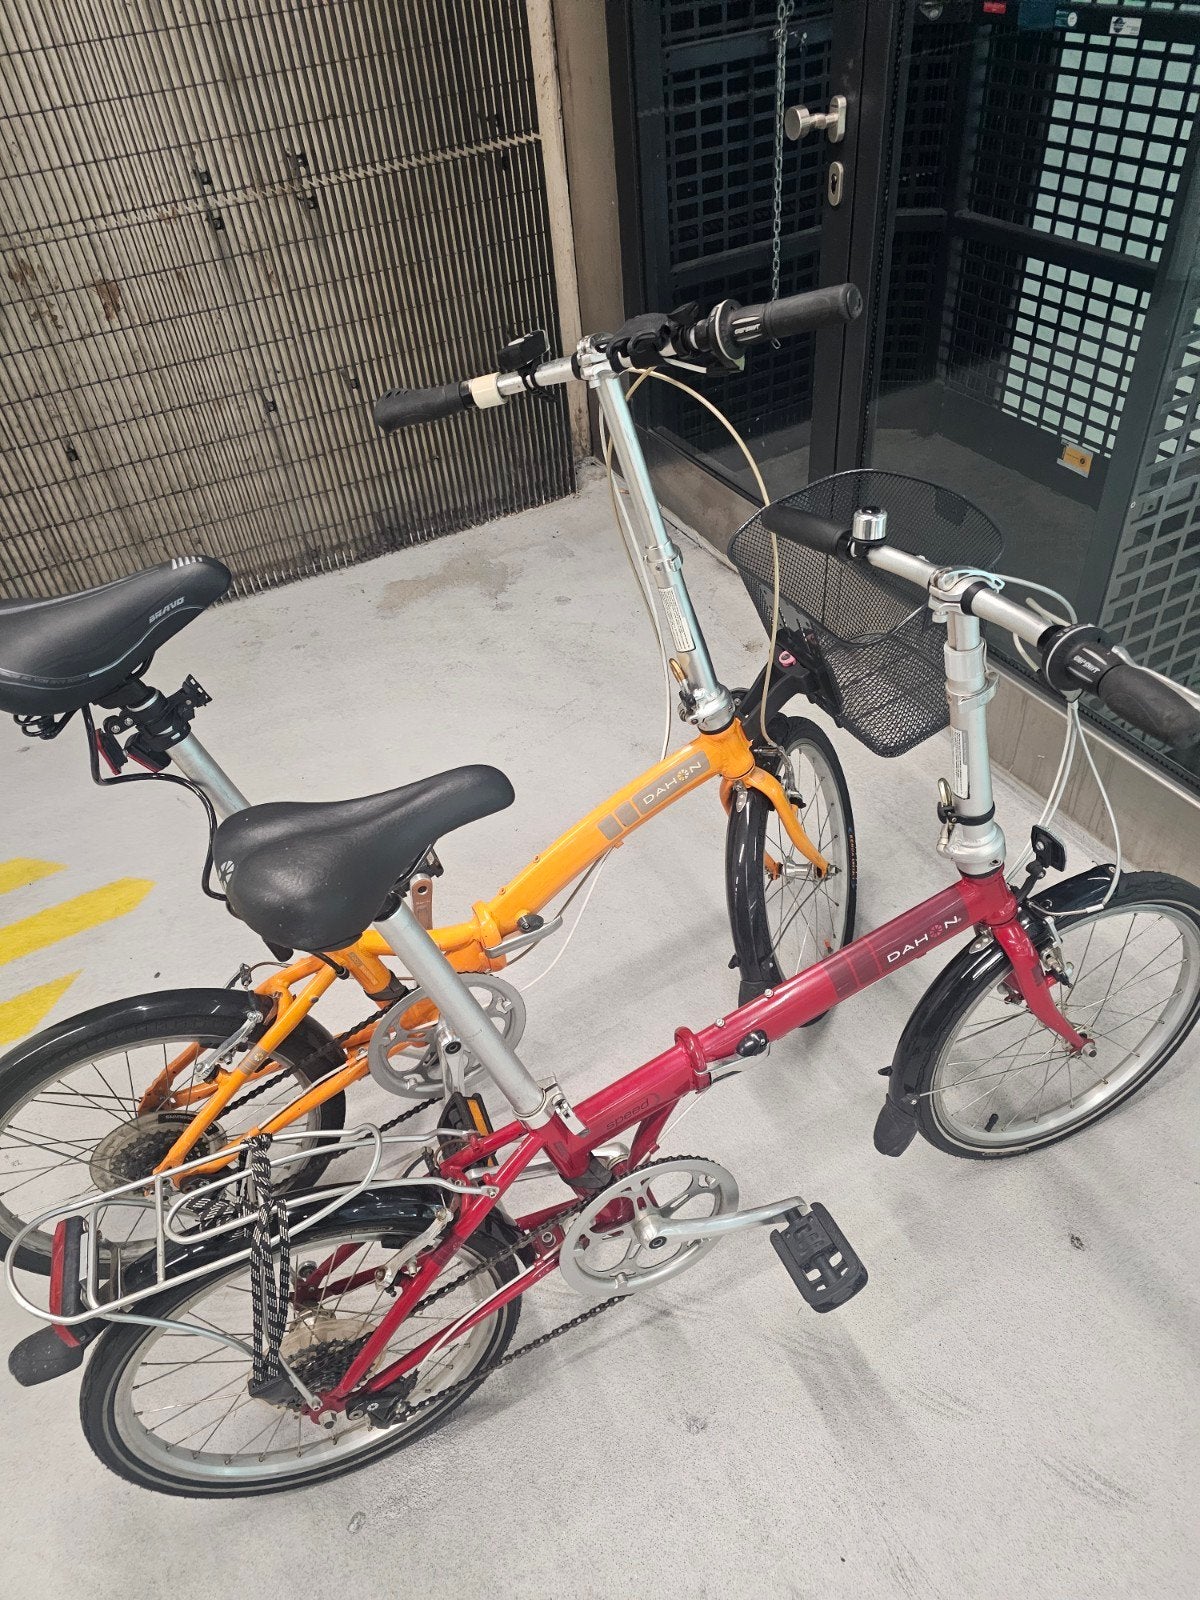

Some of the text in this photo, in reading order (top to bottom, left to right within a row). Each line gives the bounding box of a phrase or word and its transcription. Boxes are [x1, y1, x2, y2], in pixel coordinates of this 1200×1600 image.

[149, 596, 185, 623] BRAVO
[643, 761, 702, 805] DAHON
[887, 915, 959, 963] DAHON
[606, 1098, 649, 1129] speed
